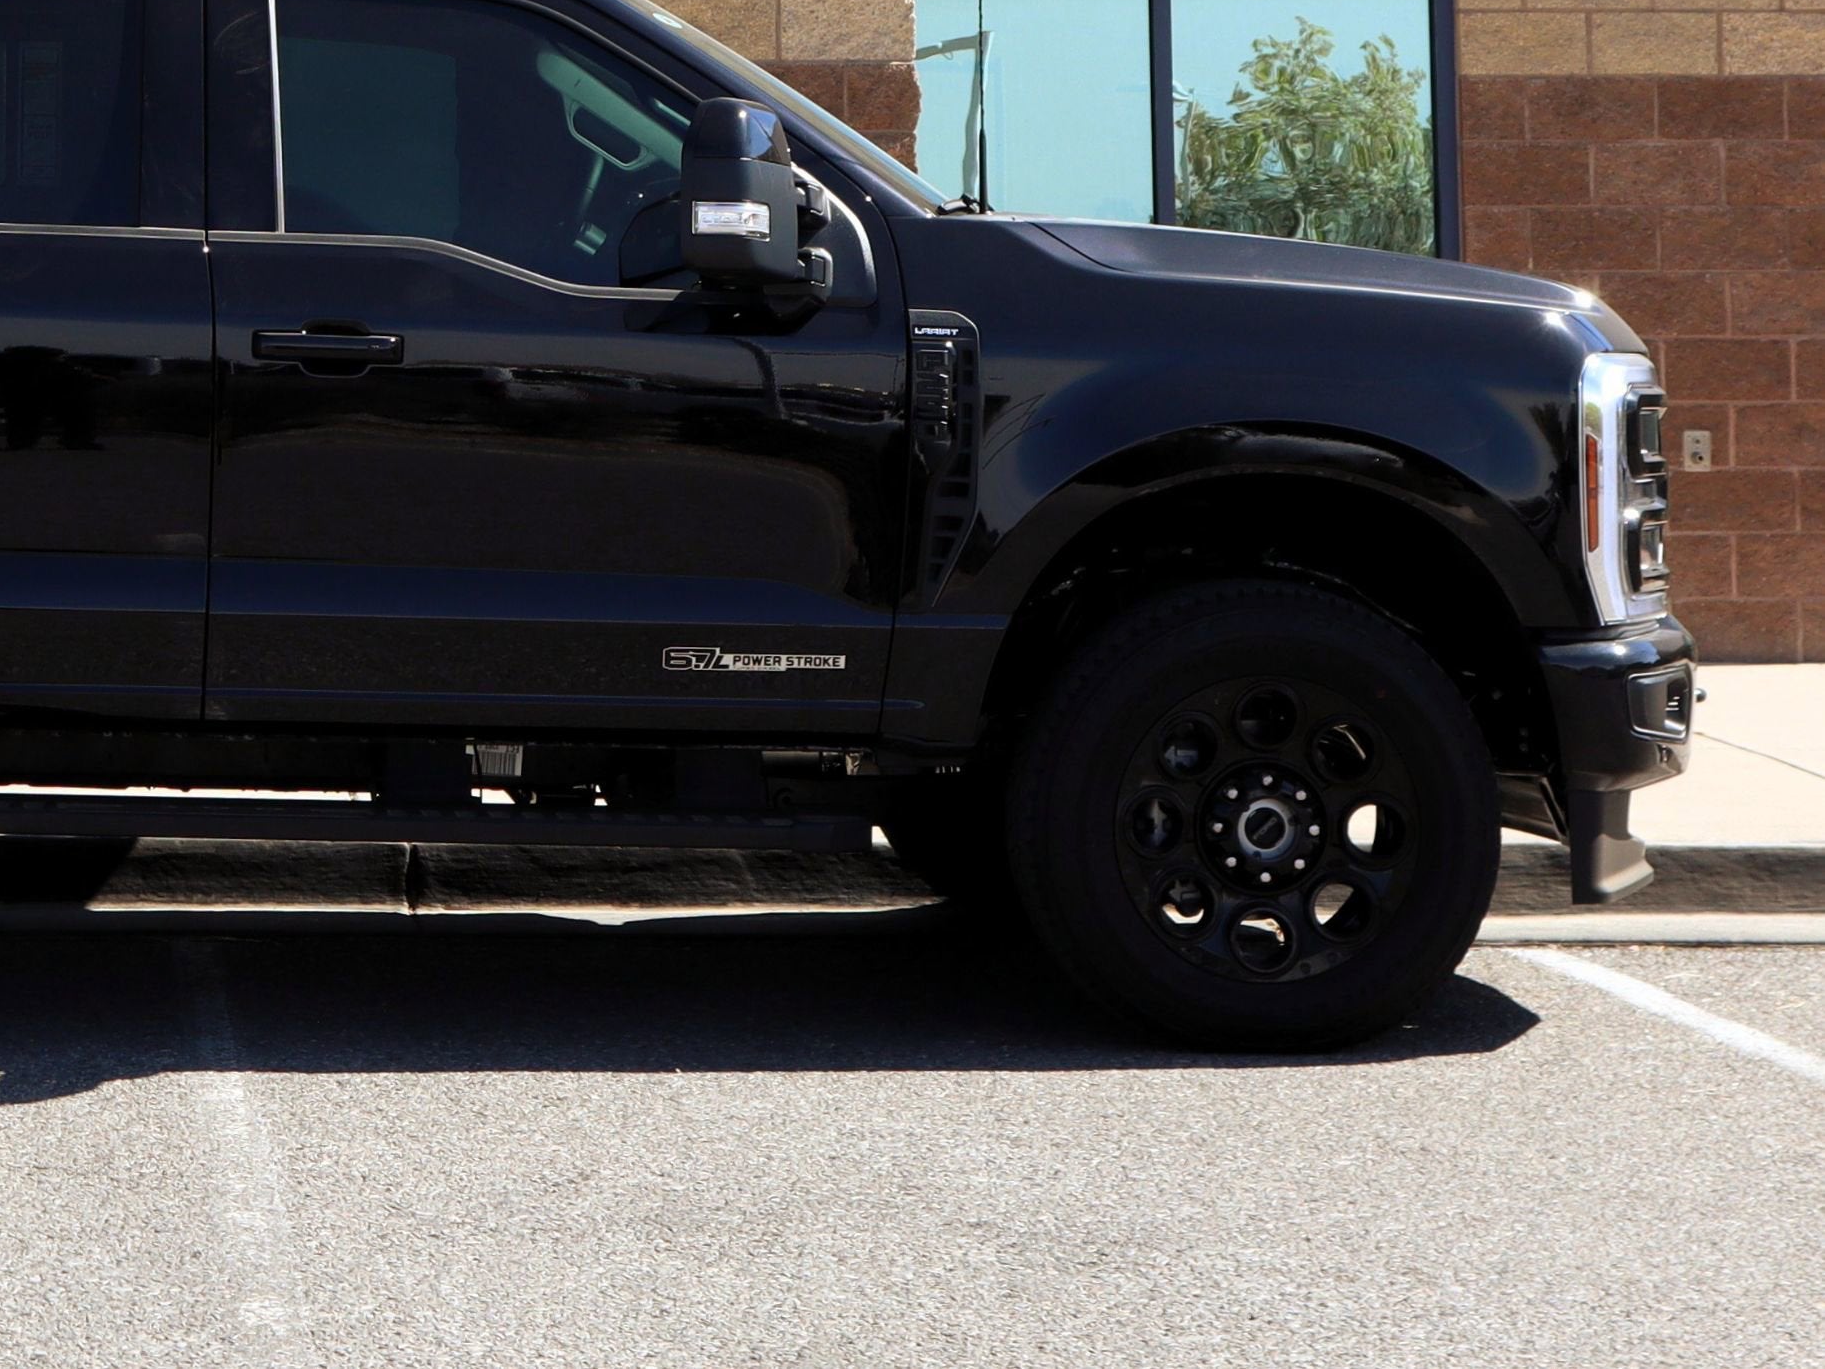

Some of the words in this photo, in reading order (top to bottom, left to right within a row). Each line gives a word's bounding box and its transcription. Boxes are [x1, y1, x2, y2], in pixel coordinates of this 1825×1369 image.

[914, 326, 959, 336] LARIAT
[662, 647, 730, 671] 6.7L
[732, 655, 781, 667] POWER
[785, 655, 842, 667] STROKE
